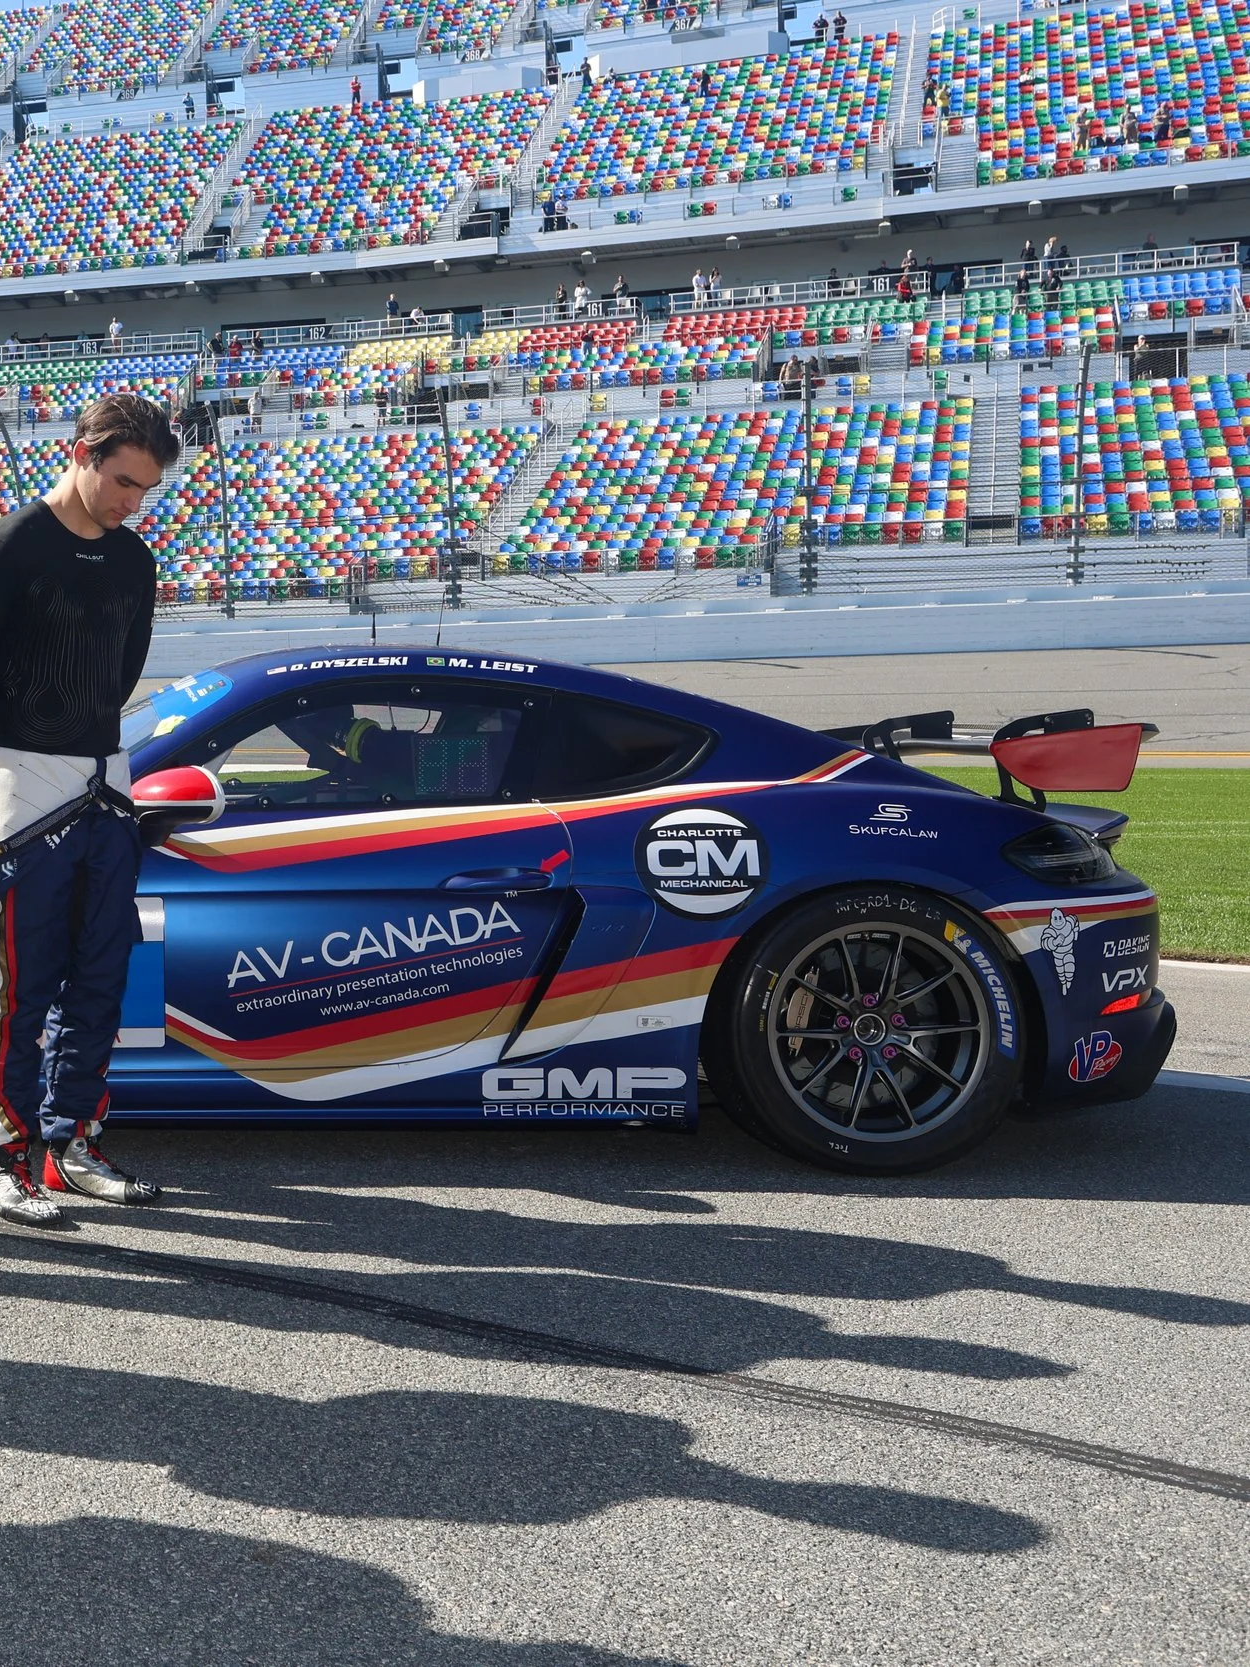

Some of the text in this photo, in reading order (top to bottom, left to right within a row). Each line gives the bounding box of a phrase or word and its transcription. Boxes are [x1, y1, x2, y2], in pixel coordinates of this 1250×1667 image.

[675, 18, 691, 30] 367
[465, 50, 480, 61] 368
[120, 88, 135, 99] 369
[872, 277, 890, 292] 161
[587, 302, 603, 317] 161
[309, 327, 326, 340] 162
[82, 342, 97, 354] 163
[310, 656, 408, 669] DYSZELSKI
[448, 658, 538, 673] M. LEIST
[657, 829, 742, 838] CHARLOTTE
[848, 824, 938, 839] SKUFCALAW
[646, 839, 761, 877] CM
[660, 880, 748, 888] MECHANICAL
[236, 945, 523, 1013] extraordinary presentation technologies
[1102, 964, 1149, 992] VPX
[320, 982, 450, 1017] www.av-canada.com
[970, 951, 1013, 1049] MICHELIN
[1069, 1030, 1112, 1081] VP
[482, 1067, 687, 1100] GMP
[483, 1103, 686, 1118] PERFORMANCE
